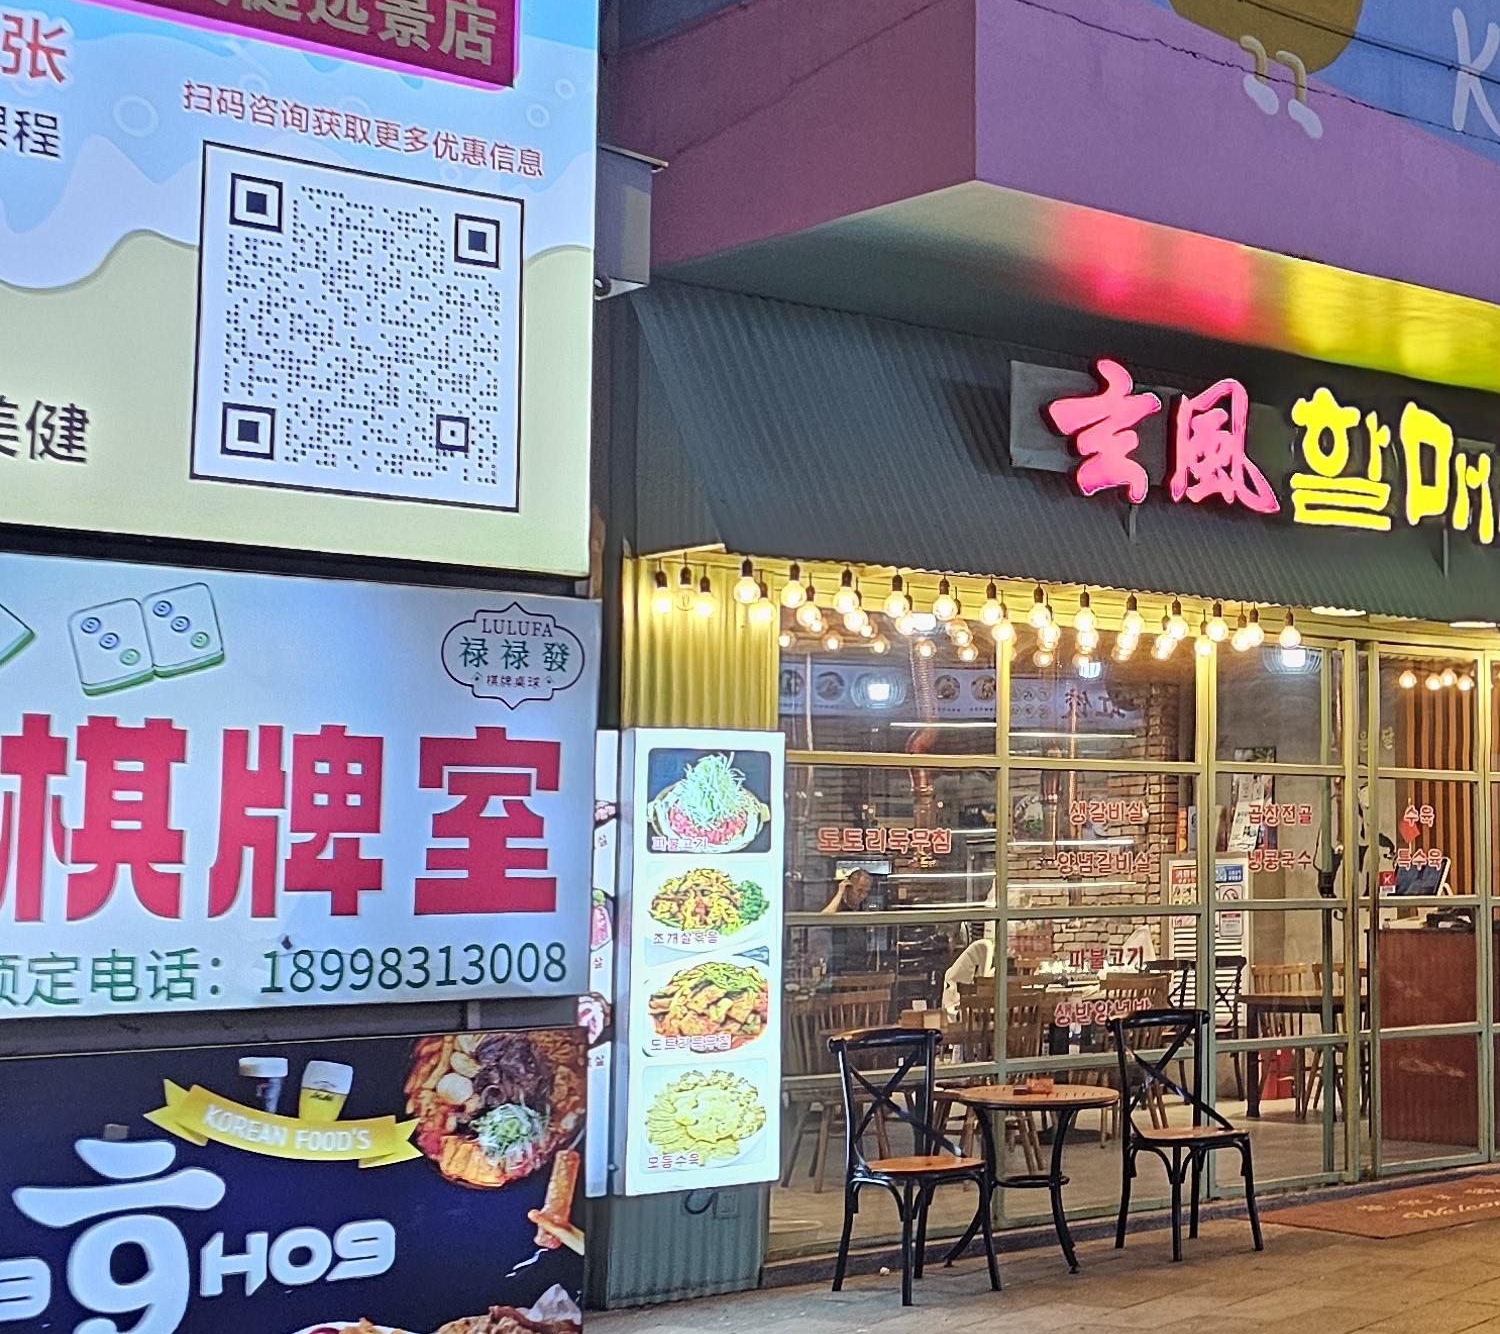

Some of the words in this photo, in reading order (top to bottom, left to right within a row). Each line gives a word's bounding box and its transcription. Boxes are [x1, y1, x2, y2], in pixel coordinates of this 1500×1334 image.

[181, 79, 543, 178] 扫码咨询获取更多优惠信息
[482, 618, 553, 638] LULUFA
[1069, 800, 1144, 825] 생갈비살
[1248, 803, 1313, 826] 곱창전골
[1404, 804, 1435, 827] 수육
[818, 827, 952, 854] 도토리묵무침
[1057, 851, 1151, 876] 양념갈비살
[1247, 848, 1312, 872] 냉콩국수
[1396, 848, 1443, 870] 특수육
[1068, 946, 1144, 971] 파불고기
[203, 1103, 287, 1149] KOREAN
[295, 1125, 372, 1152] FOOD'S
